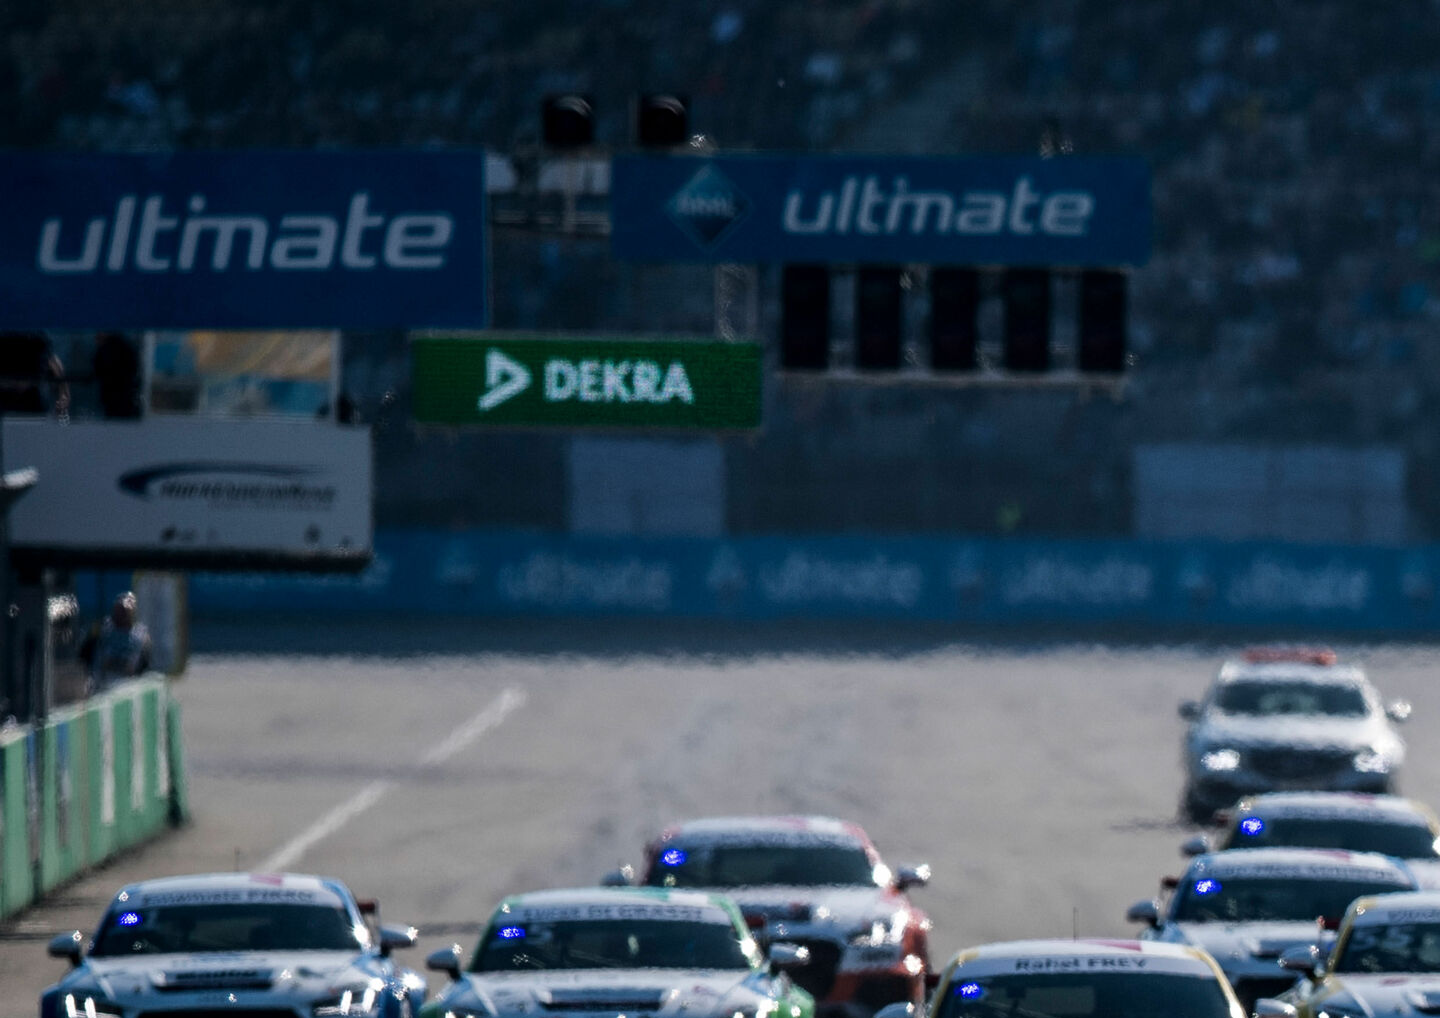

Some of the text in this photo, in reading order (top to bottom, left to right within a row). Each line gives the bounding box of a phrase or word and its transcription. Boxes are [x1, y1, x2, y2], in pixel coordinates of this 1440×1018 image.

[781, 176, 1095, 237] ultimate
[37, 193, 455, 273] ultimate
[543, 359, 695, 403] DEKRA
[1087, 957, 1148, 970] FREY
